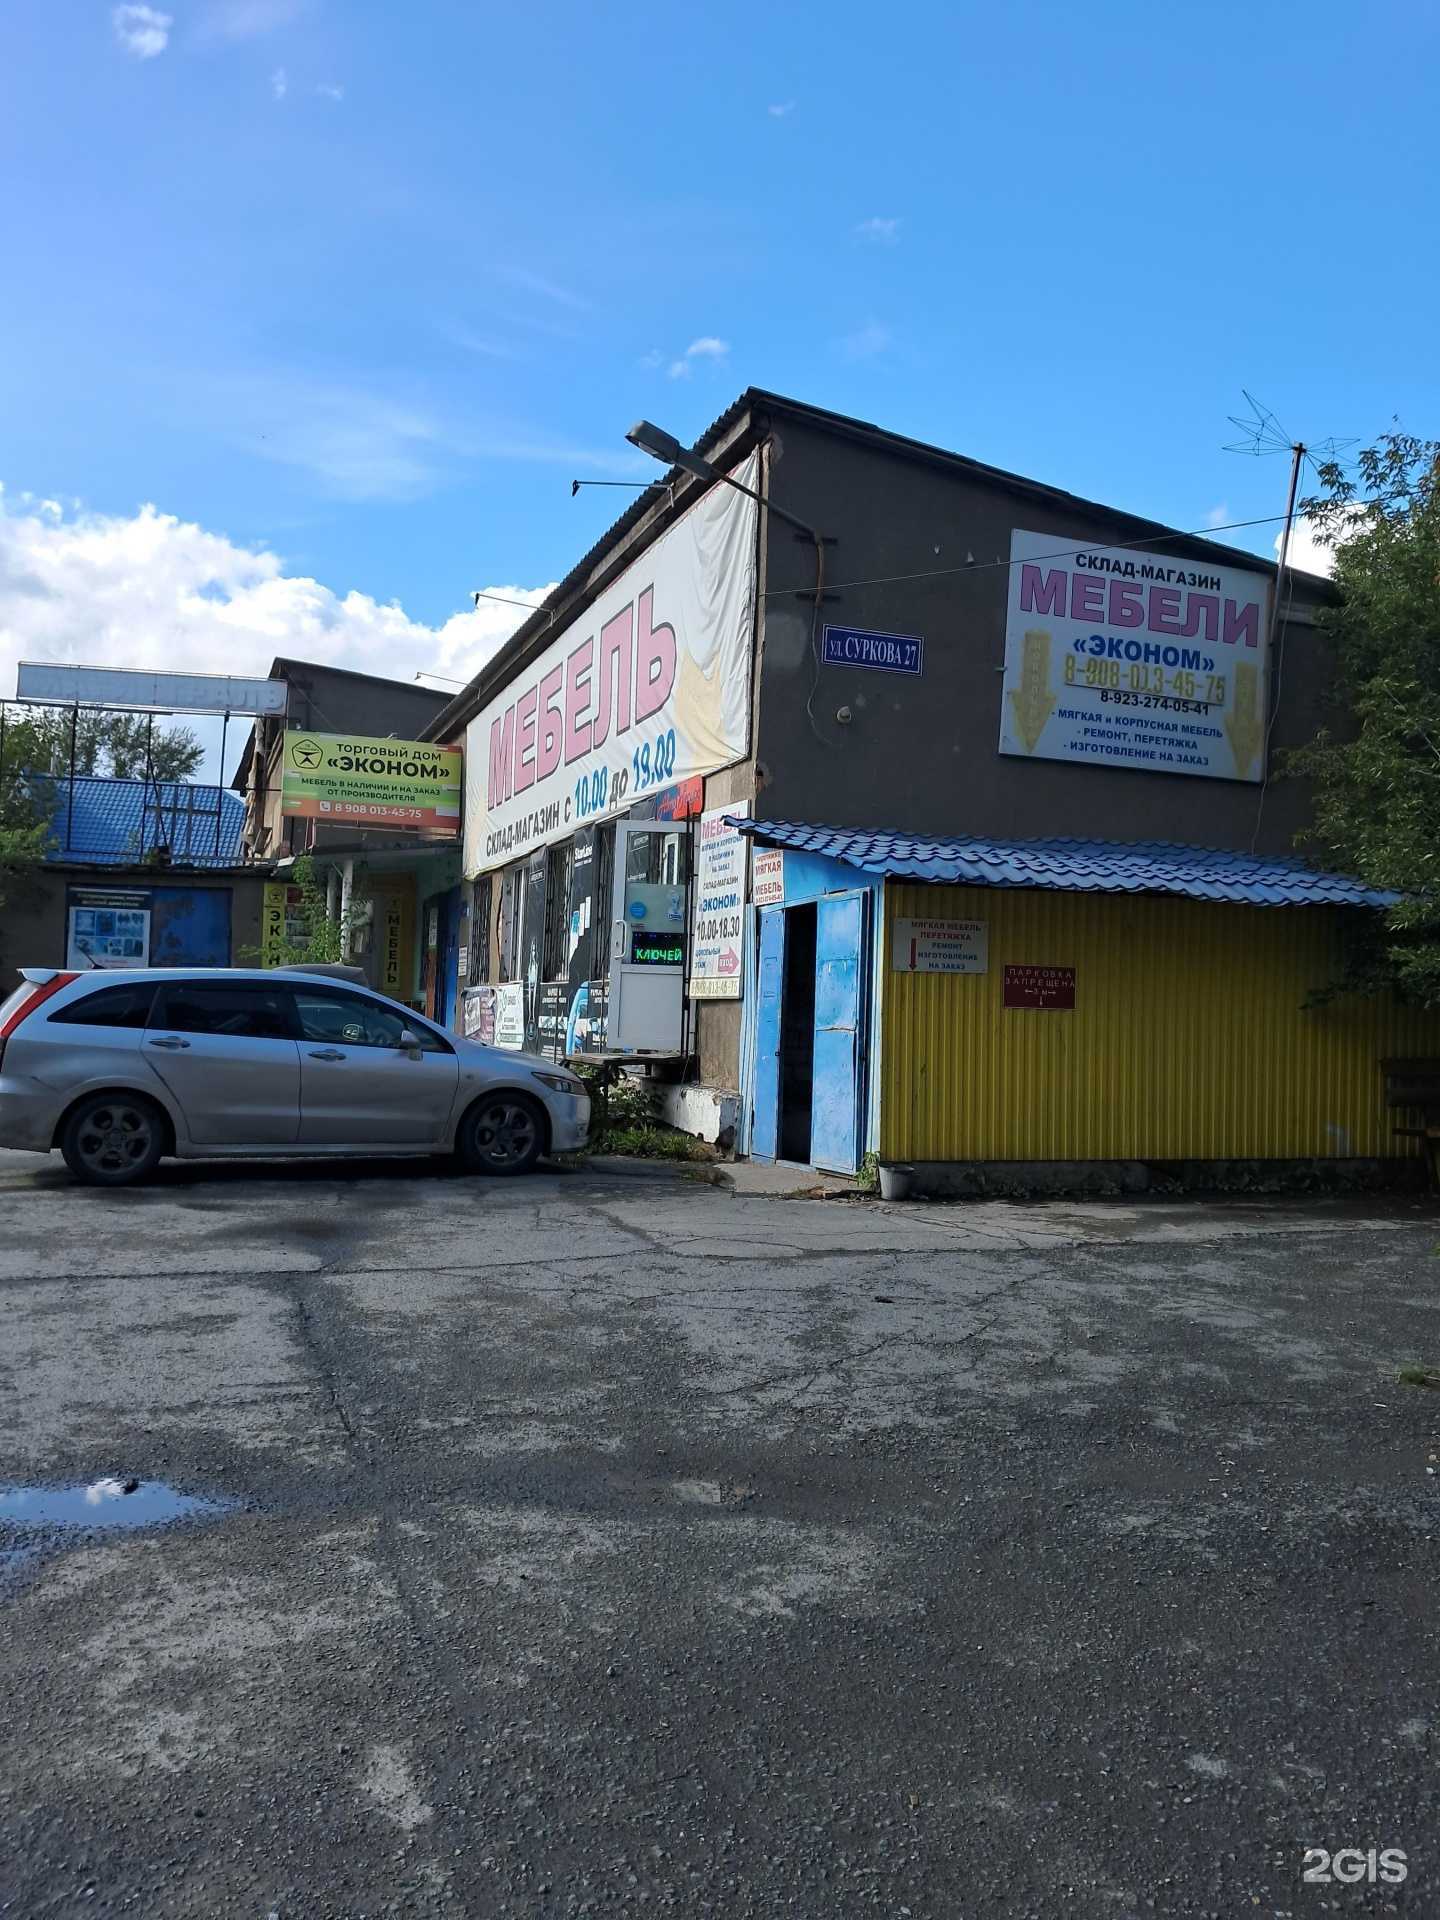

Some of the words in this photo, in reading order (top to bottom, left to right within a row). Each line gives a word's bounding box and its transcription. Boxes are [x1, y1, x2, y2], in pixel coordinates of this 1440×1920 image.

[1075, 553, 1222, 592] СКЛАД-МАГАЗИН
[1019, 564, 1260, 649] МЕБЕЛИ
[830, 639, 843, 657] ул.
[845, 636, 902, 665] СУРКОВА
[905, 644, 917, 666] 27
[1073, 634, 1216, 673] «ЭКОНОМ»
[487, 582, 678, 812] МЕБЕЛЬ
[1100, 690, 1209, 716] 8-923-274-05-41
[1058, 708, 1103, 723] МЯГКАЯ
[1114, 715, 1178, 733] КОРПУСНАЯ
[1181, 724, 1224, 739] МЕБЕЛЬ
[1083, 727, 1131, 743] РЕМОНТ,
[1134, 733, 1198, 750] ПЕРЕТЯЖКА
[1070, 741, 1156, 760] ИЗГОТОВЛЕНИЕ
[1159, 751, 1174, 762] НА
[1176, 754, 1209, 766] ЗАКАЗ
[327, 756, 450, 780] «ЭКОНОМ»
[301, 777, 337, 788] МЕБЕЛЬ
[338, 779, 345, 787] В
[347, 780, 390, 792] НАЛИЧИИ
[391, 784, 398, 792] И
[399, 785, 412, 794] НА
[414, 786, 441, 796] ЗАКАЗ
[327, 788, 340, 796] ОТ
[341, 790, 416, 803] ПРОИЗВОДИТЕЛЯ
[486, 801, 560, 857] СКЛАД-МАГАЗИН
[574, 765, 608, 819] 10.00
[632, 728, 677, 792] 19.00
[334, 804, 342, 813] 8
[344, 805, 367, 815] 908
[369, 807, 423, 819] 013-45-75
[755, 880, 783, 896] МЕБЕЛЬ
[696, 916, 740, 942] 10.00-18.30
[911, 921, 946, 930] МЯГКАЯ
[947, 923, 982, 932] МЕБЕЛЬ
[920, 932, 972, 942] ПЕРЕТЯЖКА
[387, 914, 401, 984] МЕБЕЛЬ
[635, 947, 683, 962] КЛЮЧЕЙ
[917, 952, 978, 962] ИЗГОТОВЛЕНИЕ
[931, 942, 963, 951] РЕМОНТ
[941, 963, 966, 971] ЗАКАЗ
[1009, 968, 1072, 979] ПАРКОВКА
[1005, 978, 1075, 988] ЗАПРЕЩЕНА
